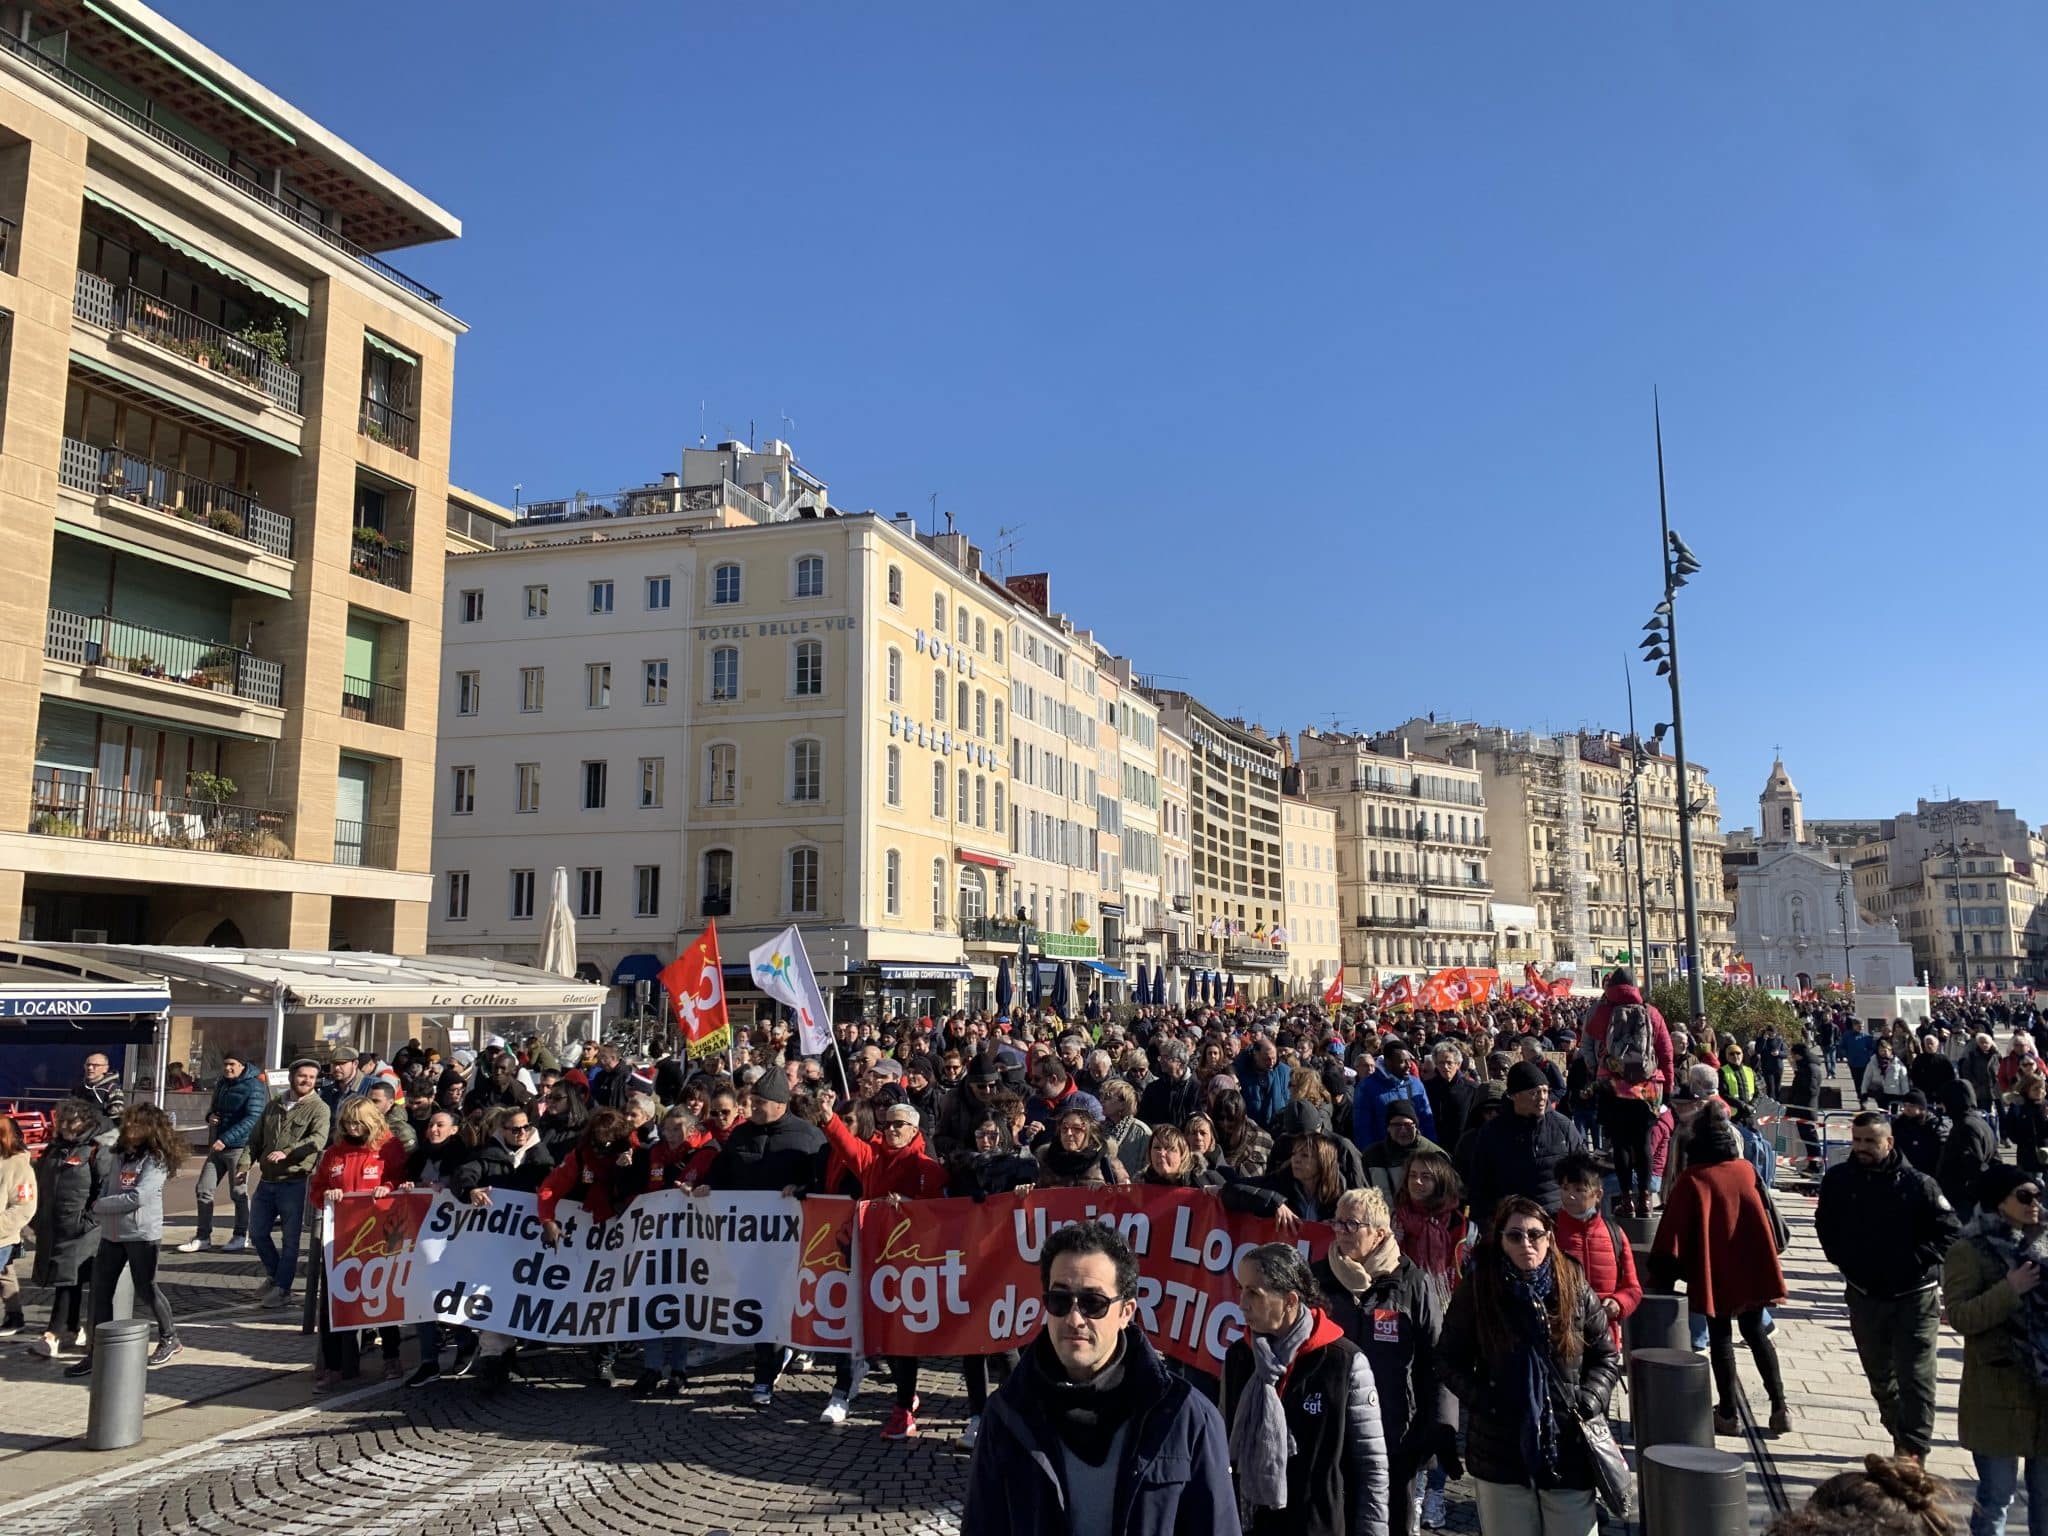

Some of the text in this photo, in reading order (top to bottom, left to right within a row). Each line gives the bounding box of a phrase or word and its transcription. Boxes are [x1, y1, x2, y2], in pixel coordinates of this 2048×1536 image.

[698, 617, 857, 640] HOTEL BELLE-VUE
[915, 627, 977, 680] HOTEL
[890, 710, 998, 772] BELLE-VUE
[902, 970, 920, 979] GRAND
[920, 970, 945, 979] COMPTOIR
[14, 1000, 92, 1016] LOCARNO
[307, 992, 598, 1006] Brasserie Le Collins Glacier
[430, 1201, 800, 1251] Syndict des Territoriaux
[800, 1222, 851, 1272] la
[875, 1218, 966, 1264] la
[332, 1240, 414, 1317] cgt
[512, 1248, 710, 1293] de la Ville
[870, 1250, 971, 1333] cgt
[433, 1281, 764, 1338] de MARTIGUES
[989, 1284, 1041, 1340] de
[1375, 1320, 1398, 1335] cgt
[1303, 1400, 1322, 1415] cgt
